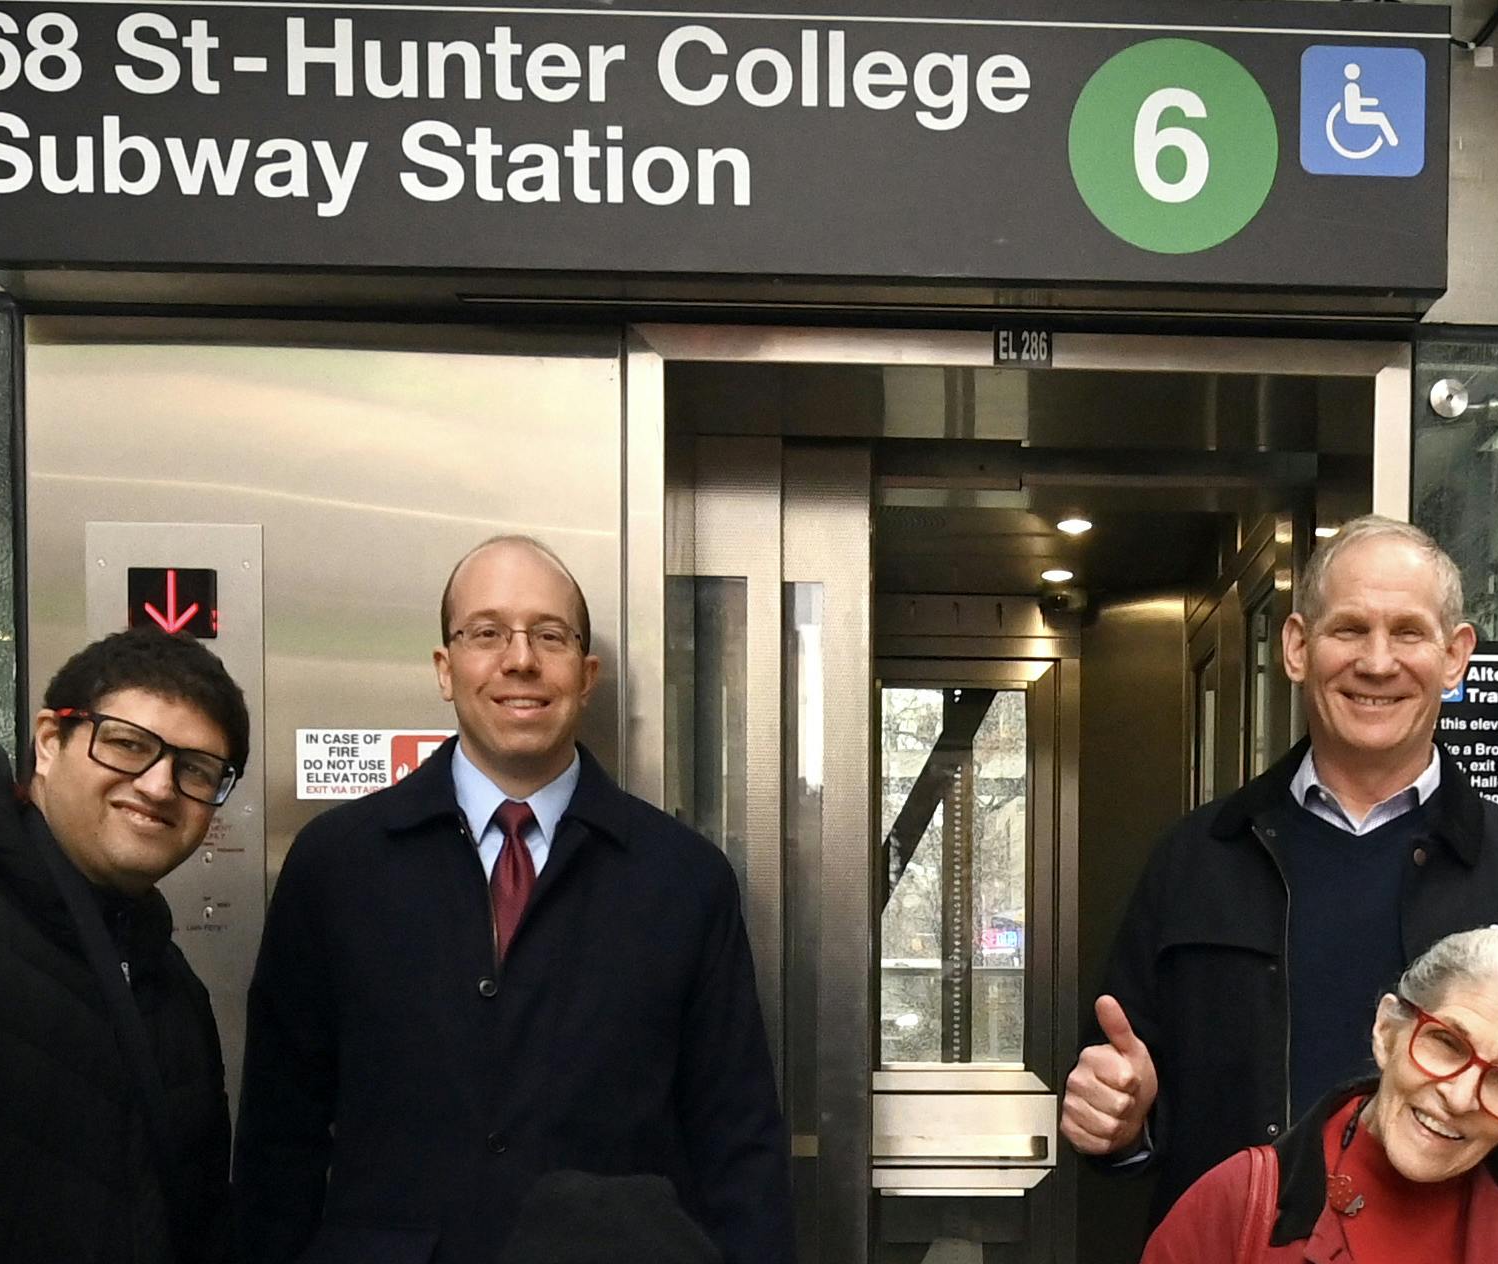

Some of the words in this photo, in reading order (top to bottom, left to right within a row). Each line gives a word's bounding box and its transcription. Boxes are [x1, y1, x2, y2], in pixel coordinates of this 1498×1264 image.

[658, 25, 1031, 131] College
[1134, 87, 1209, 203] 6
[400, 120, 751, 206] Station
[999, 330, 1017, 360] EL
[1021, 330, 1048, 361] 286
[1441, 717, 1467, 730] this
[305, 733, 318, 744] IN
[322, 733, 359, 744] CASE
[363, 733, 381, 744] OF
[329, 746, 359, 757] FIRE
[1463, 745, 1472, 755] a
[304, 759, 322, 770] DO
[327, 759, 353, 770] NOT
[359, 759, 385, 770] USE
[1470, 760, 1495, 772] exit
[306, 772, 387, 784] ELEVATORS
[306, 785, 328, 794] EXIT
[331, 785, 347, 794] VIA
